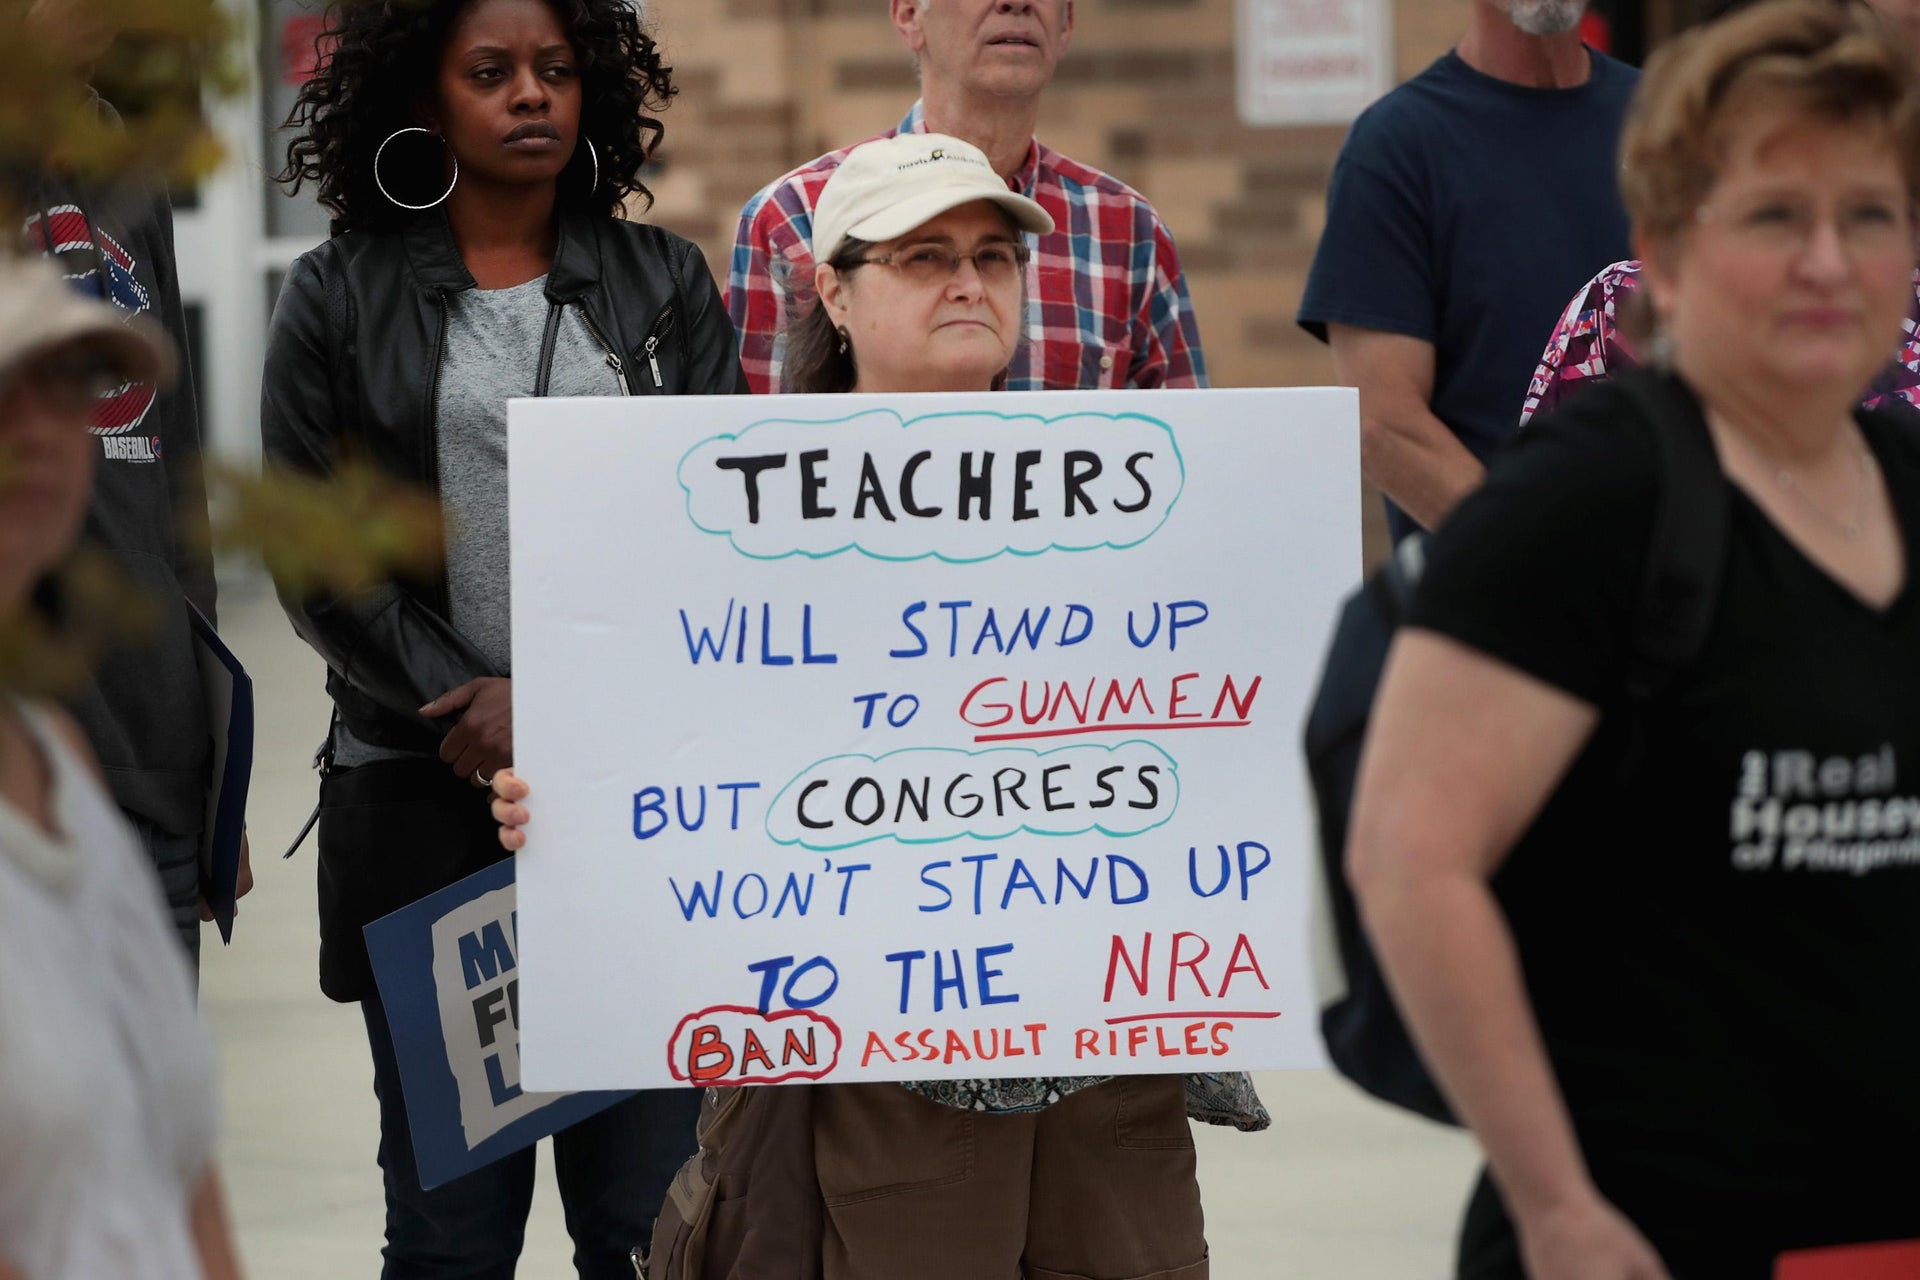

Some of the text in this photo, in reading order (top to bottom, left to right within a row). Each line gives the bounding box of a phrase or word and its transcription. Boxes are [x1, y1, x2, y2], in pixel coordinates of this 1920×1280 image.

[102, 436, 155, 459] BASEBALL
[716, 450, 1154, 523] TEACHERS
[680, 600, 1209, 666] WILL STAND UP
[853, 673, 1262, 729] TO GUNMEN
[633, 765, 1160, 840] BUT CONGRESS
[669, 841, 1271, 922] WON'T STAND UP
[458, 910, 518, 991] M
[747, 932, 1270, 1015] TO THE NRA
[686, 1022, 1234, 1080] BAN ASSAULT RIFLES
